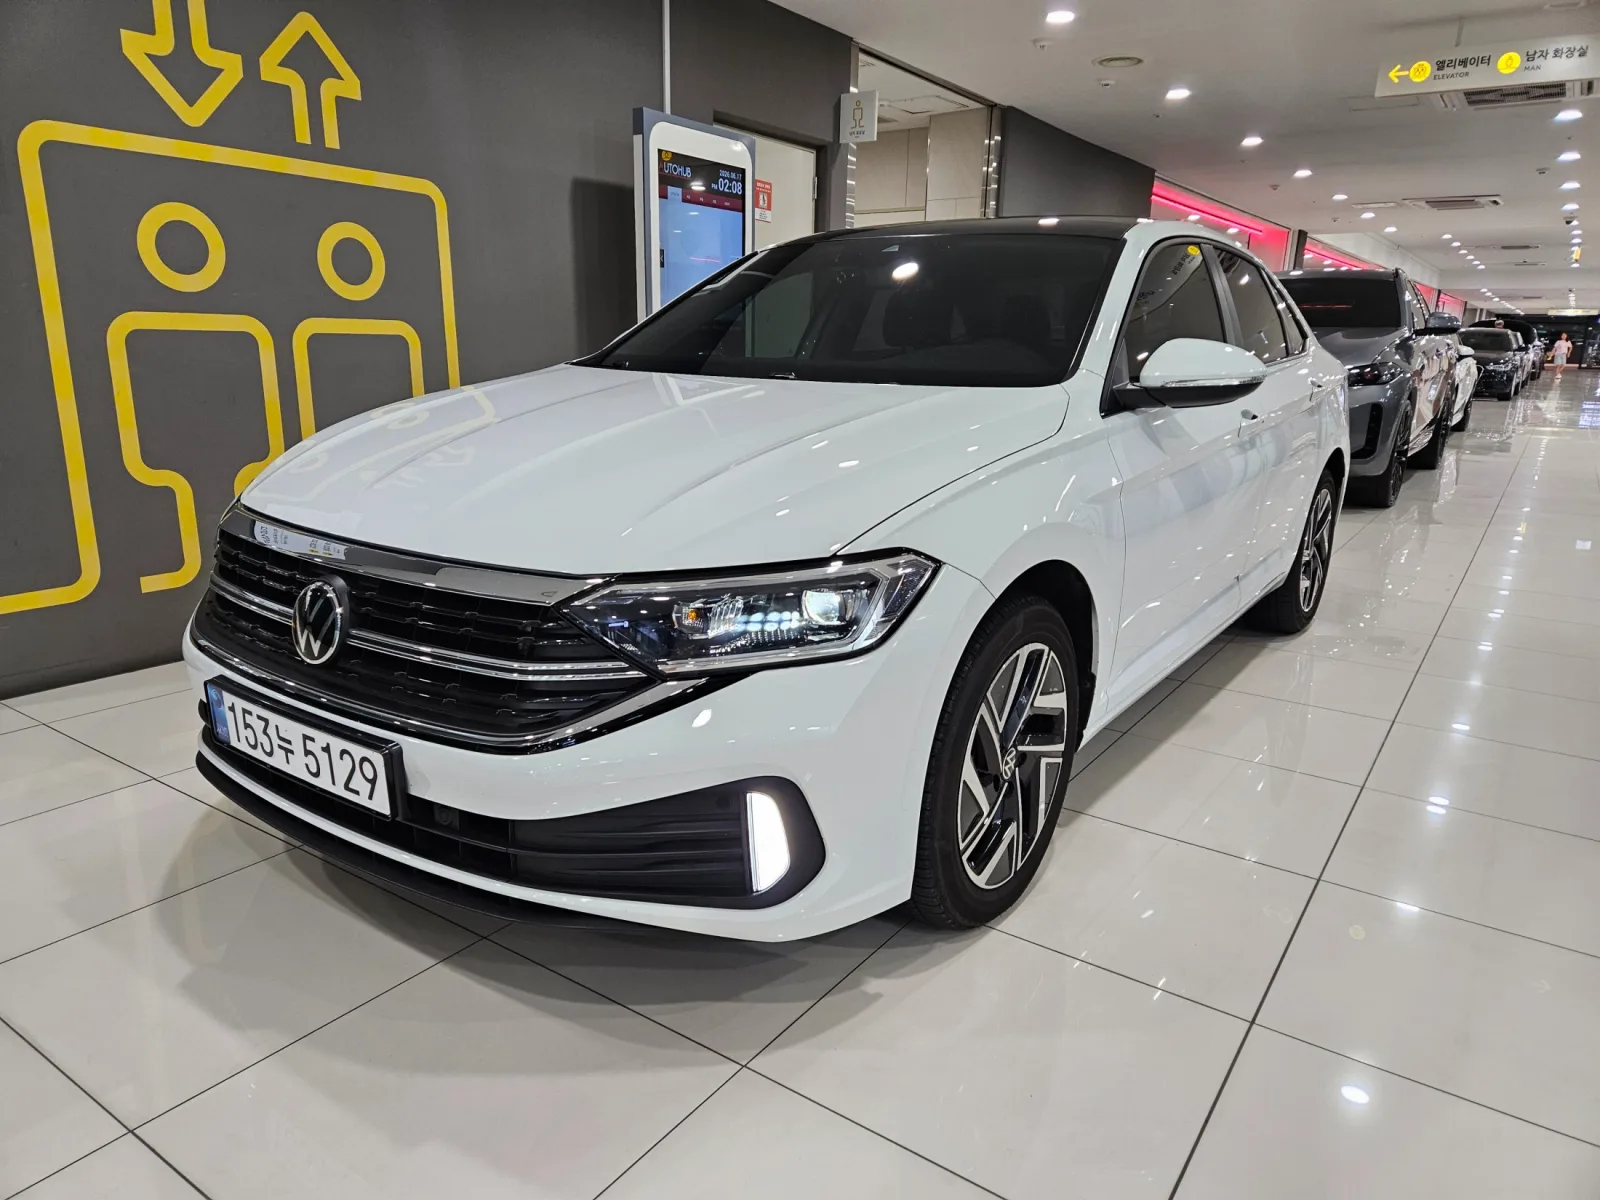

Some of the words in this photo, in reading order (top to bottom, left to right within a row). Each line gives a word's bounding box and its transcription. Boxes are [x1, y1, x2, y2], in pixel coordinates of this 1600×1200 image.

[1435, 54, 1492, 71] 엘리베이터
[1525, 48, 1550, 63] 남자
[1551, 45, 1590, 60] 화장실
[1433, 71, 1470, 81] ELEVATOR
[1523, 64, 1542, 72] MAN
[718, 178, 743, 195] 02:08
[228, 702, 295, 765] 153누
[302, 733, 378, 801] 5129
